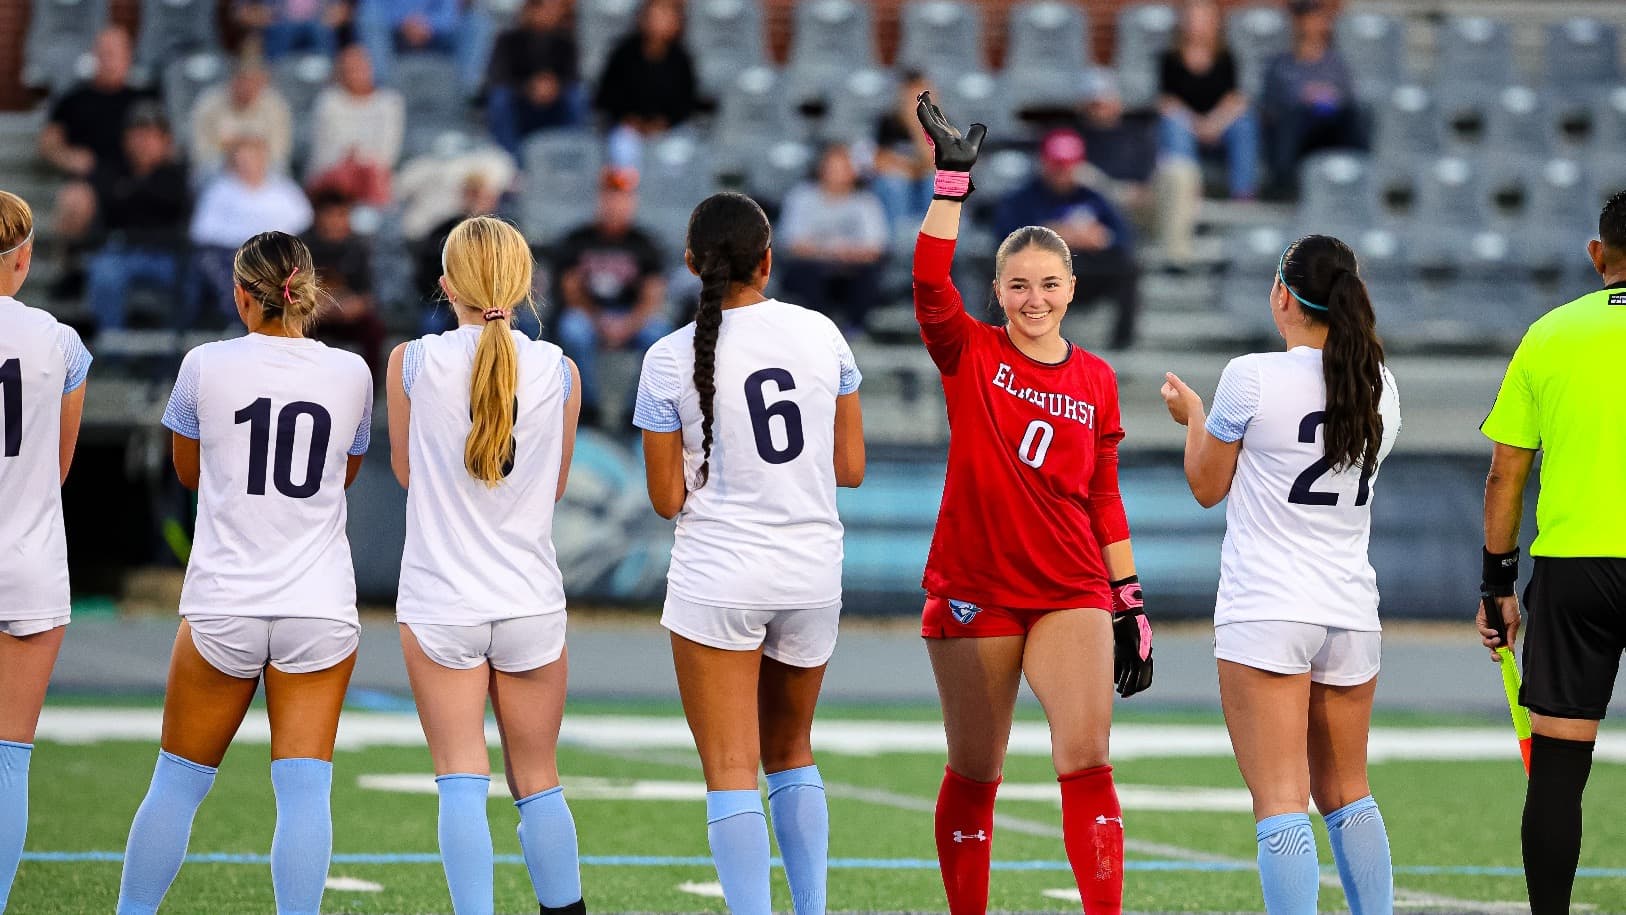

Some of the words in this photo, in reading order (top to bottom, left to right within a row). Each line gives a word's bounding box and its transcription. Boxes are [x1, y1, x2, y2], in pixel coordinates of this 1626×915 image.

[235, 397, 332, 498] 10
[744, 367, 804, 464] 6
[1018, 419, 1054, 469] 0
